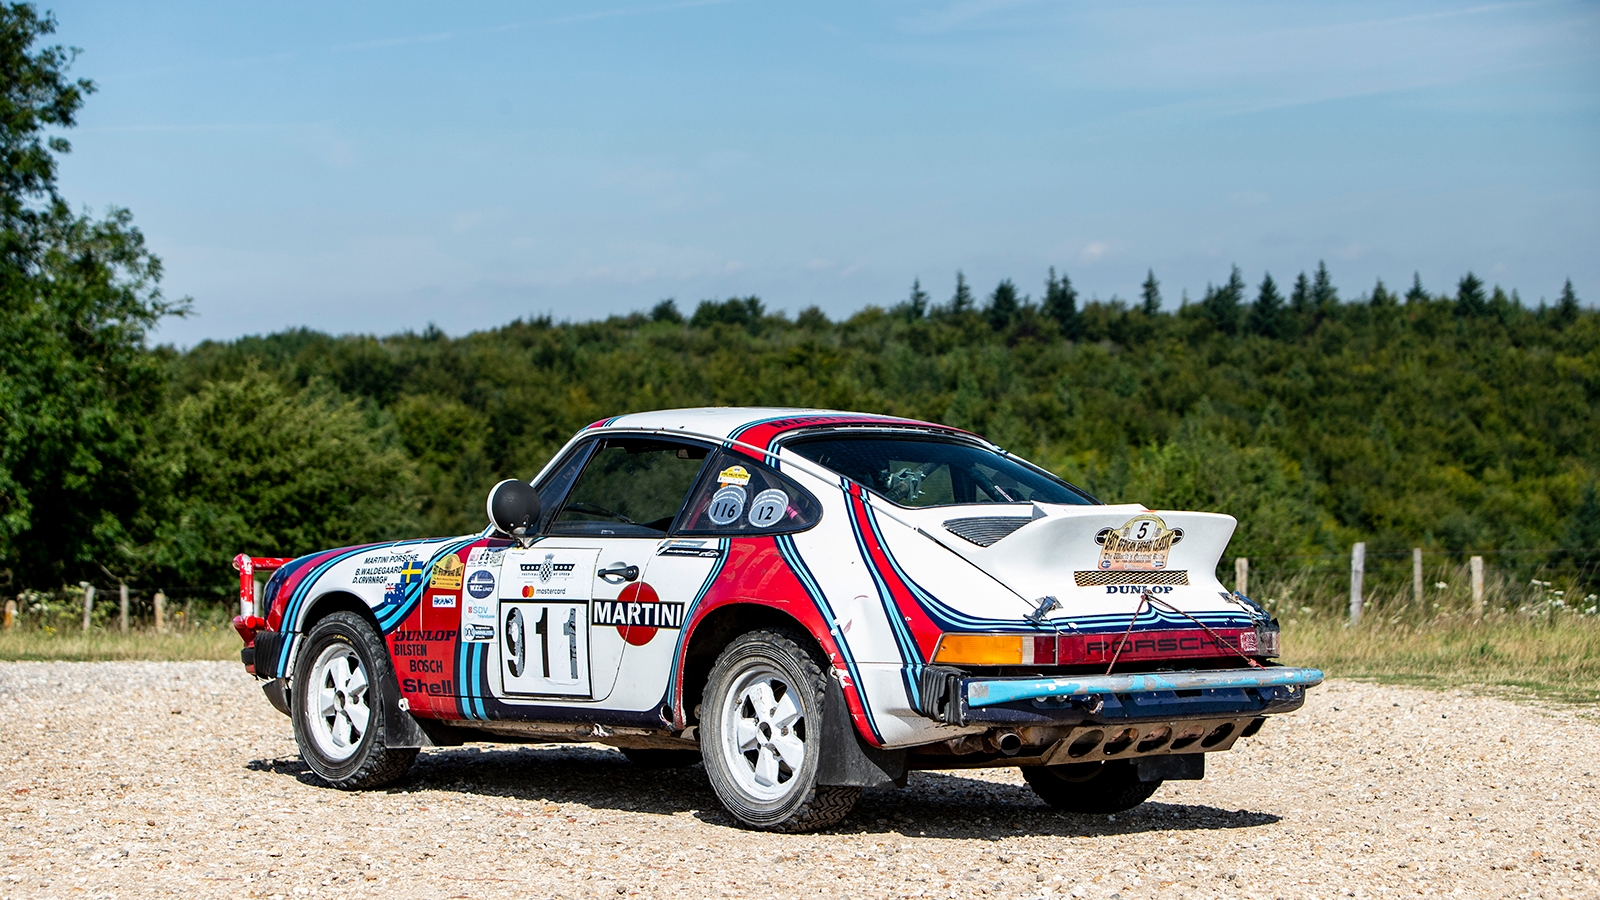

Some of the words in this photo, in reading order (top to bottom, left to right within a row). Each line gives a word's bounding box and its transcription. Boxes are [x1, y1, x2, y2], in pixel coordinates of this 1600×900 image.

[713, 503, 736, 518] 116
[757, 506, 774, 520] 12
[1136, 522, 1149, 539] 5
[364, 556, 390, 564] MARTINI
[389, 554, 419, 562] PORSCHE
[355, 566, 403, 575] B.WALDEGAARD
[1106, 585, 1173, 594] DUNLOP
[473, 606, 488, 614] SDV
[593, 601, 682, 627] MARTINI
[393, 630, 456, 641] DUNLOP
[394, 644, 427, 656] BILSTEN
[505, 607, 578, 679] 911
[1087, 636, 1239, 655] PORSCHE
[409, 659, 443, 673] BOSCH
[403, 679, 452, 694] Shell
